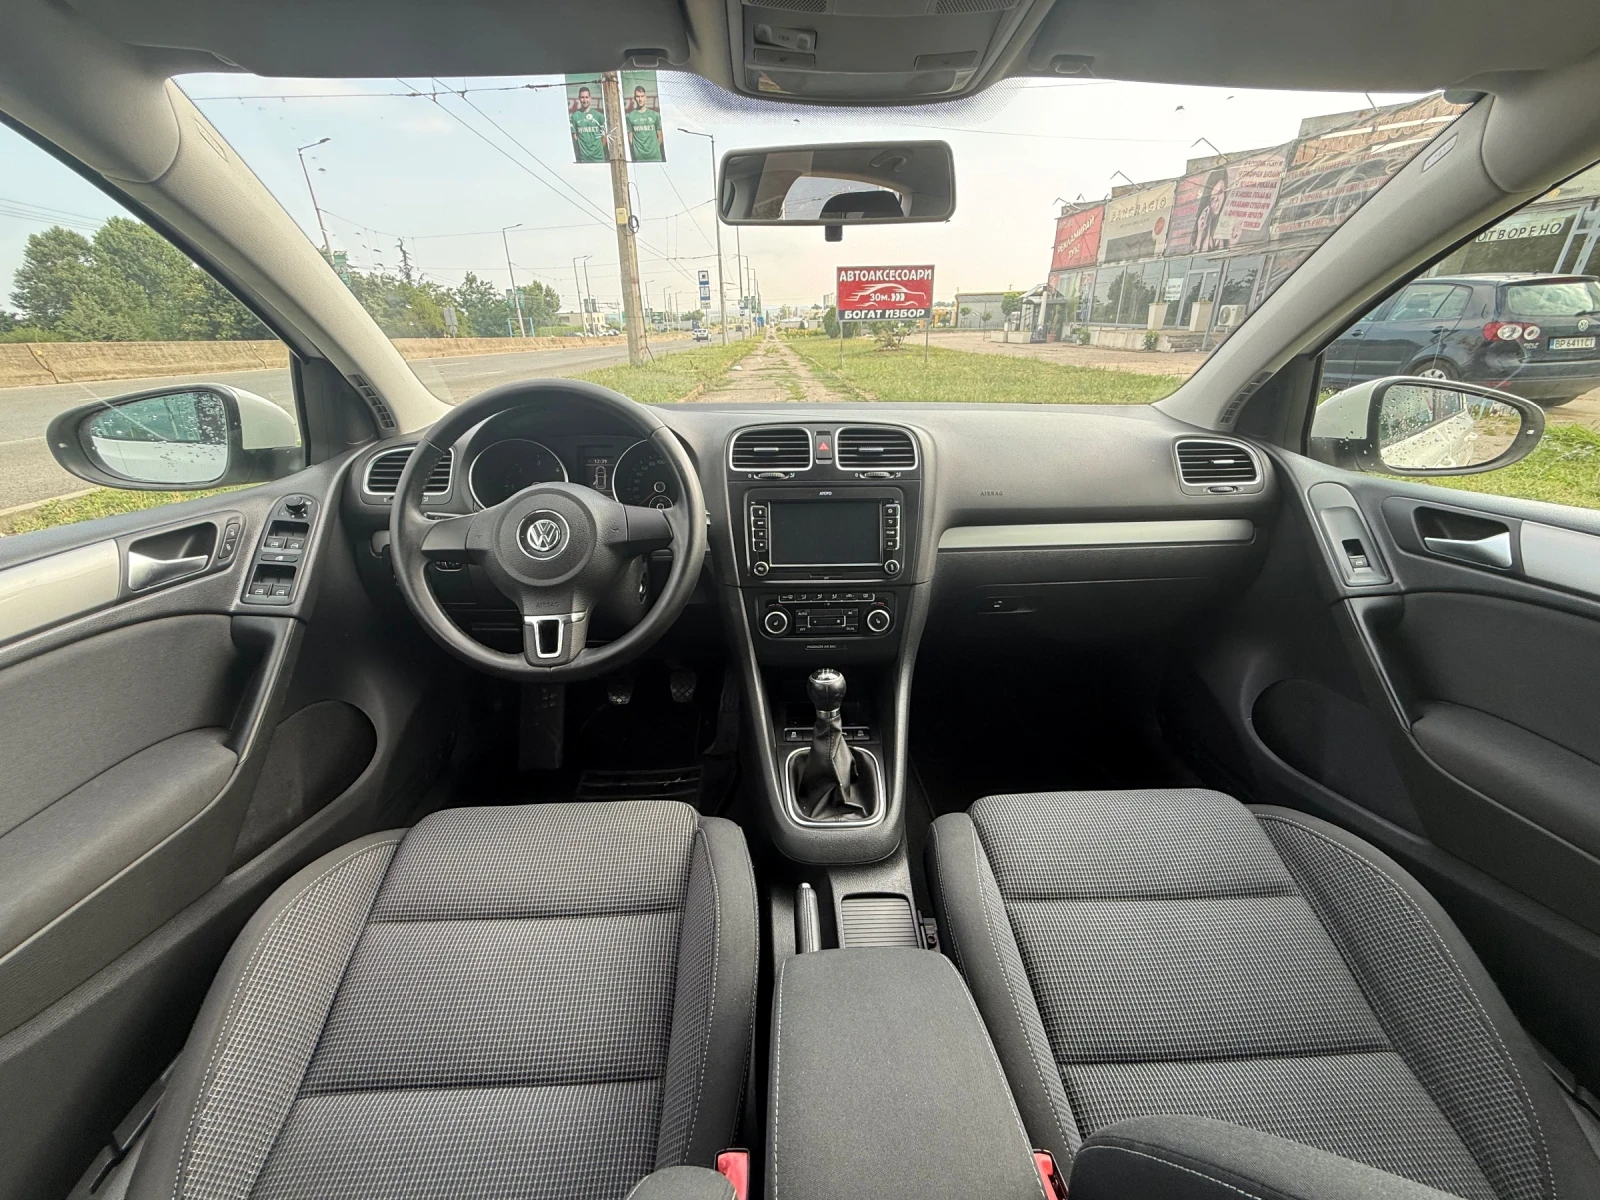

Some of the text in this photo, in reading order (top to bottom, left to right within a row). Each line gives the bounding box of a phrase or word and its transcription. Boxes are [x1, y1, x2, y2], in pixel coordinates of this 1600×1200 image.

[1057, 214, 1096, 253] РЕКЛАМИРАЙ
[1477, 222, 1563, 241] ОТВОРЕНО
[839, 269, 932, 282] АВТОАКСЕСОАРИ
[844, 308, 925, 319] БОГАТ ИЗБОР
